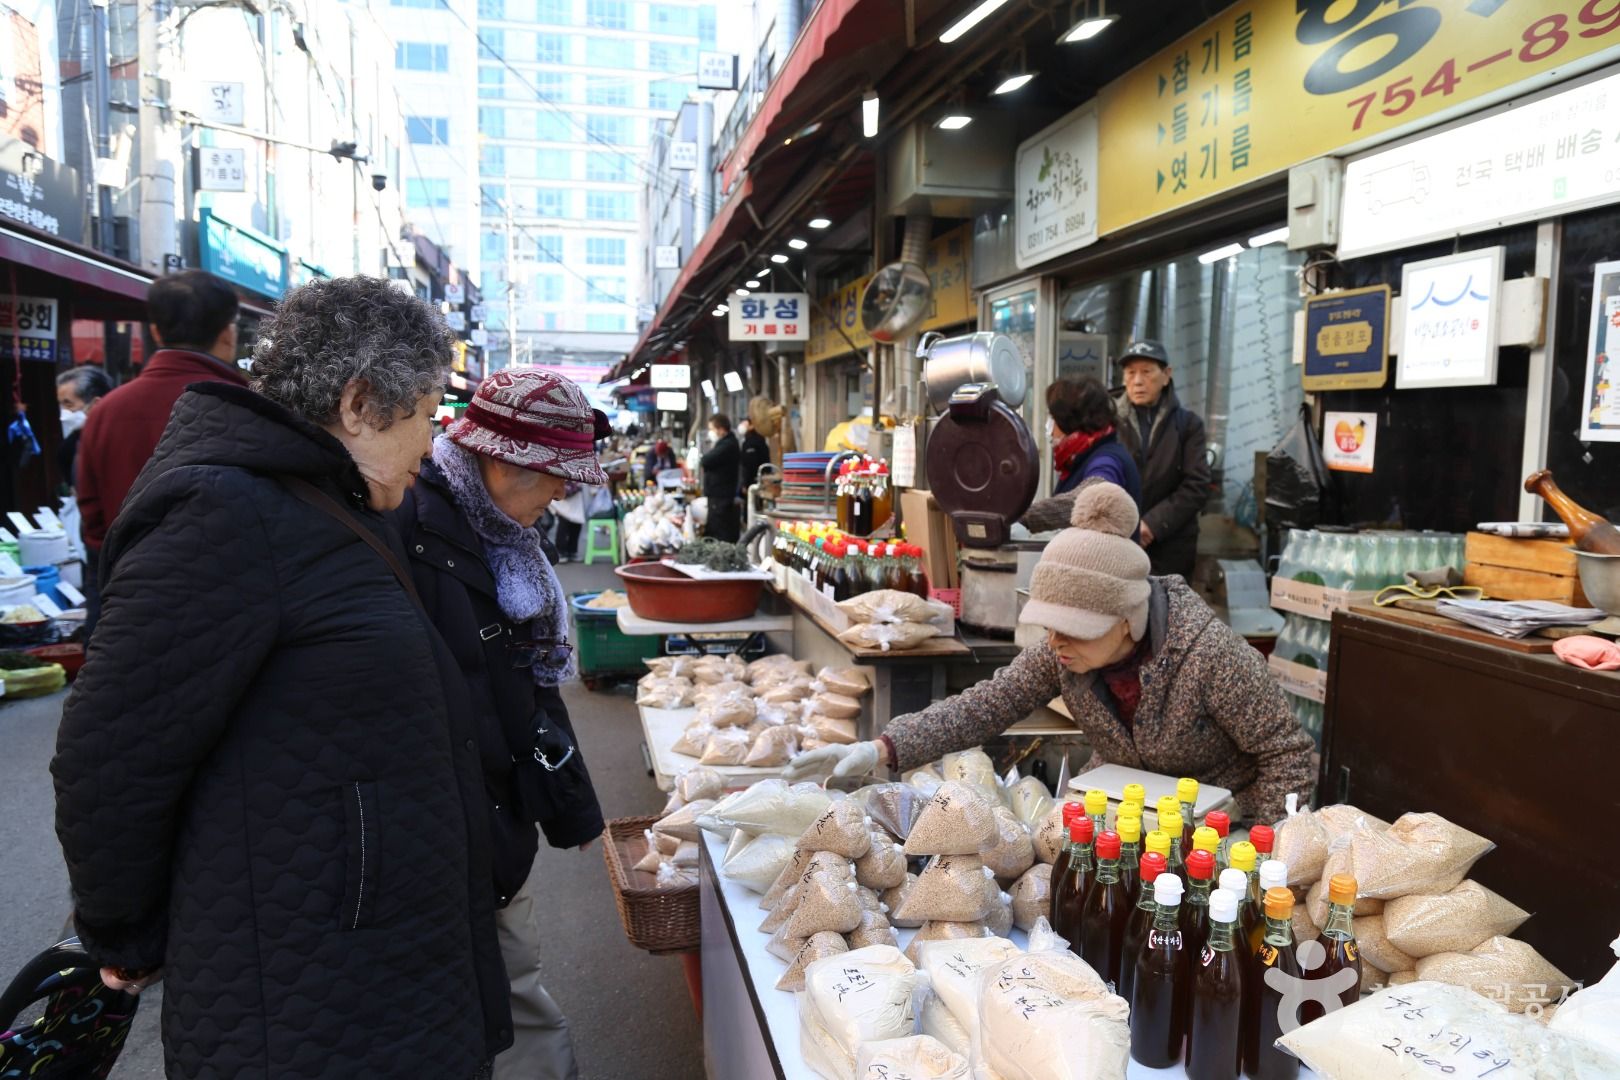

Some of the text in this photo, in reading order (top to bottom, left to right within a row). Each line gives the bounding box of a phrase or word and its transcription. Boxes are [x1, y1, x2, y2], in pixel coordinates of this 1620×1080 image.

[1172, 12, 1253, 96] 참기름
[1172, 68, 1252, 144] 들기름
[1171, 124, 1251, 194] 엿기름
[1456, 128, 1603, 188] 전국 택배 배송
[741, 298, 799, 319] 화성
[744, 324, 797, 335] 기름집
